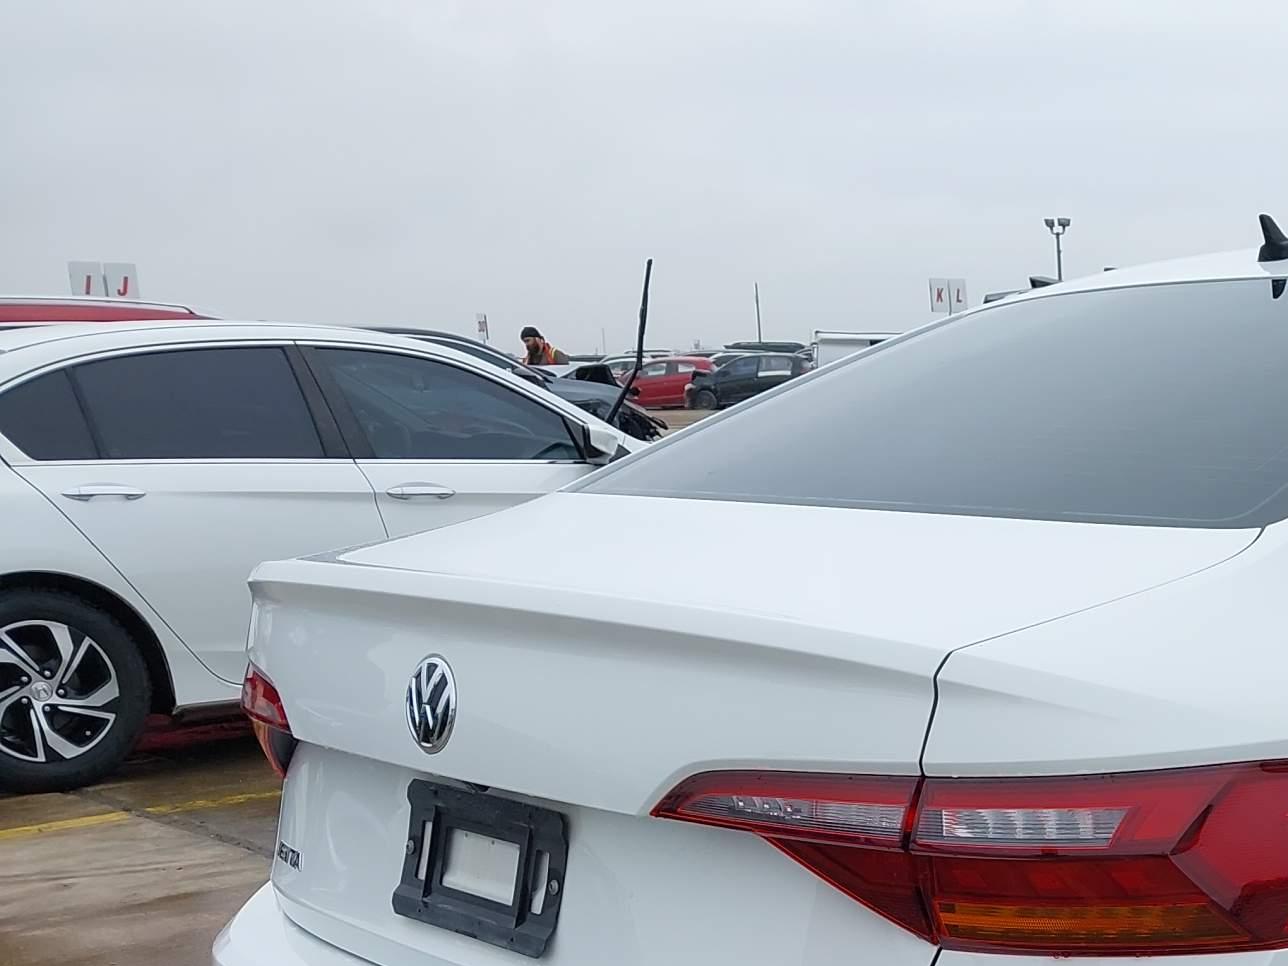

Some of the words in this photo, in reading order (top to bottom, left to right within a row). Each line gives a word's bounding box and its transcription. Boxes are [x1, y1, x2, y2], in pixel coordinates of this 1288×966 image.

[117, 276, 129, 296] J
[936, 287, 944, 303] K
[956, 287, 963, 303] L
